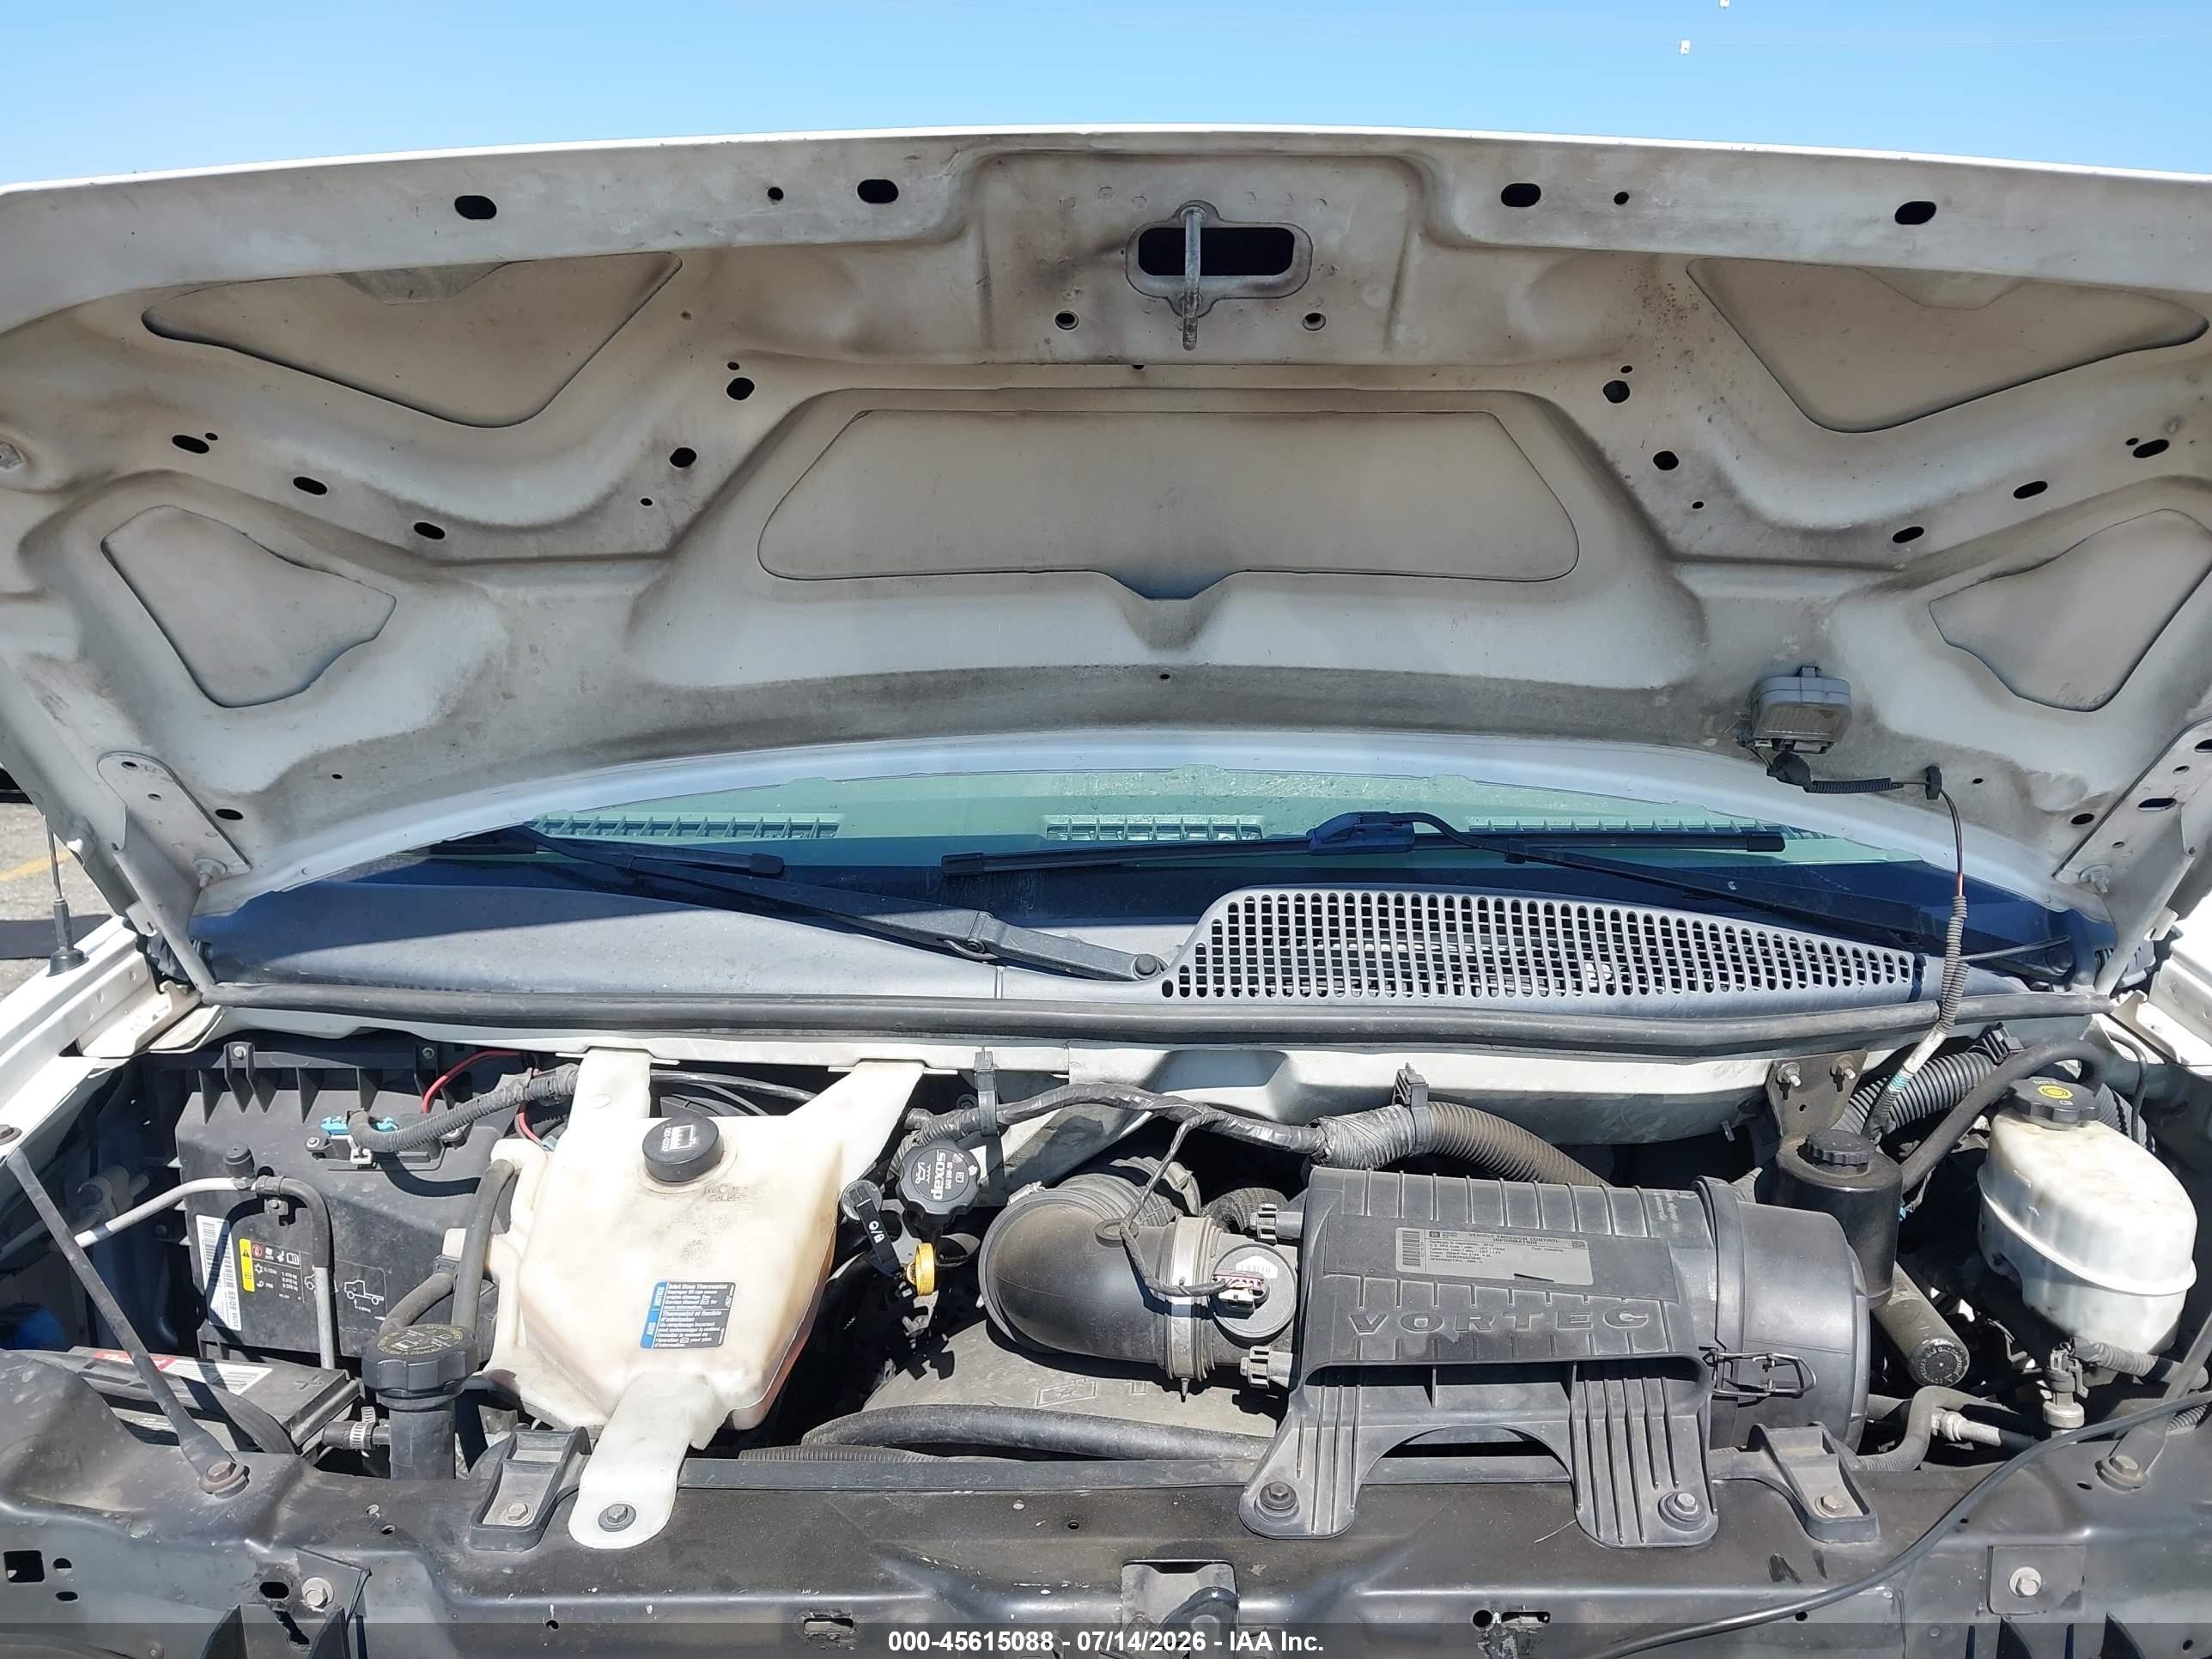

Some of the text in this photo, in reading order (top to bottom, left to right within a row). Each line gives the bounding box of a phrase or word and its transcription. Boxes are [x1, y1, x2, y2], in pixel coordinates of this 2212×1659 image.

[931, 1149, 945, 1200] dexos
[654, 1286, 665, 1305] NOTICE
[646, 1322, 655, 1336] AVIS
[1349, 1307, 1649, 1335] VORTEC
